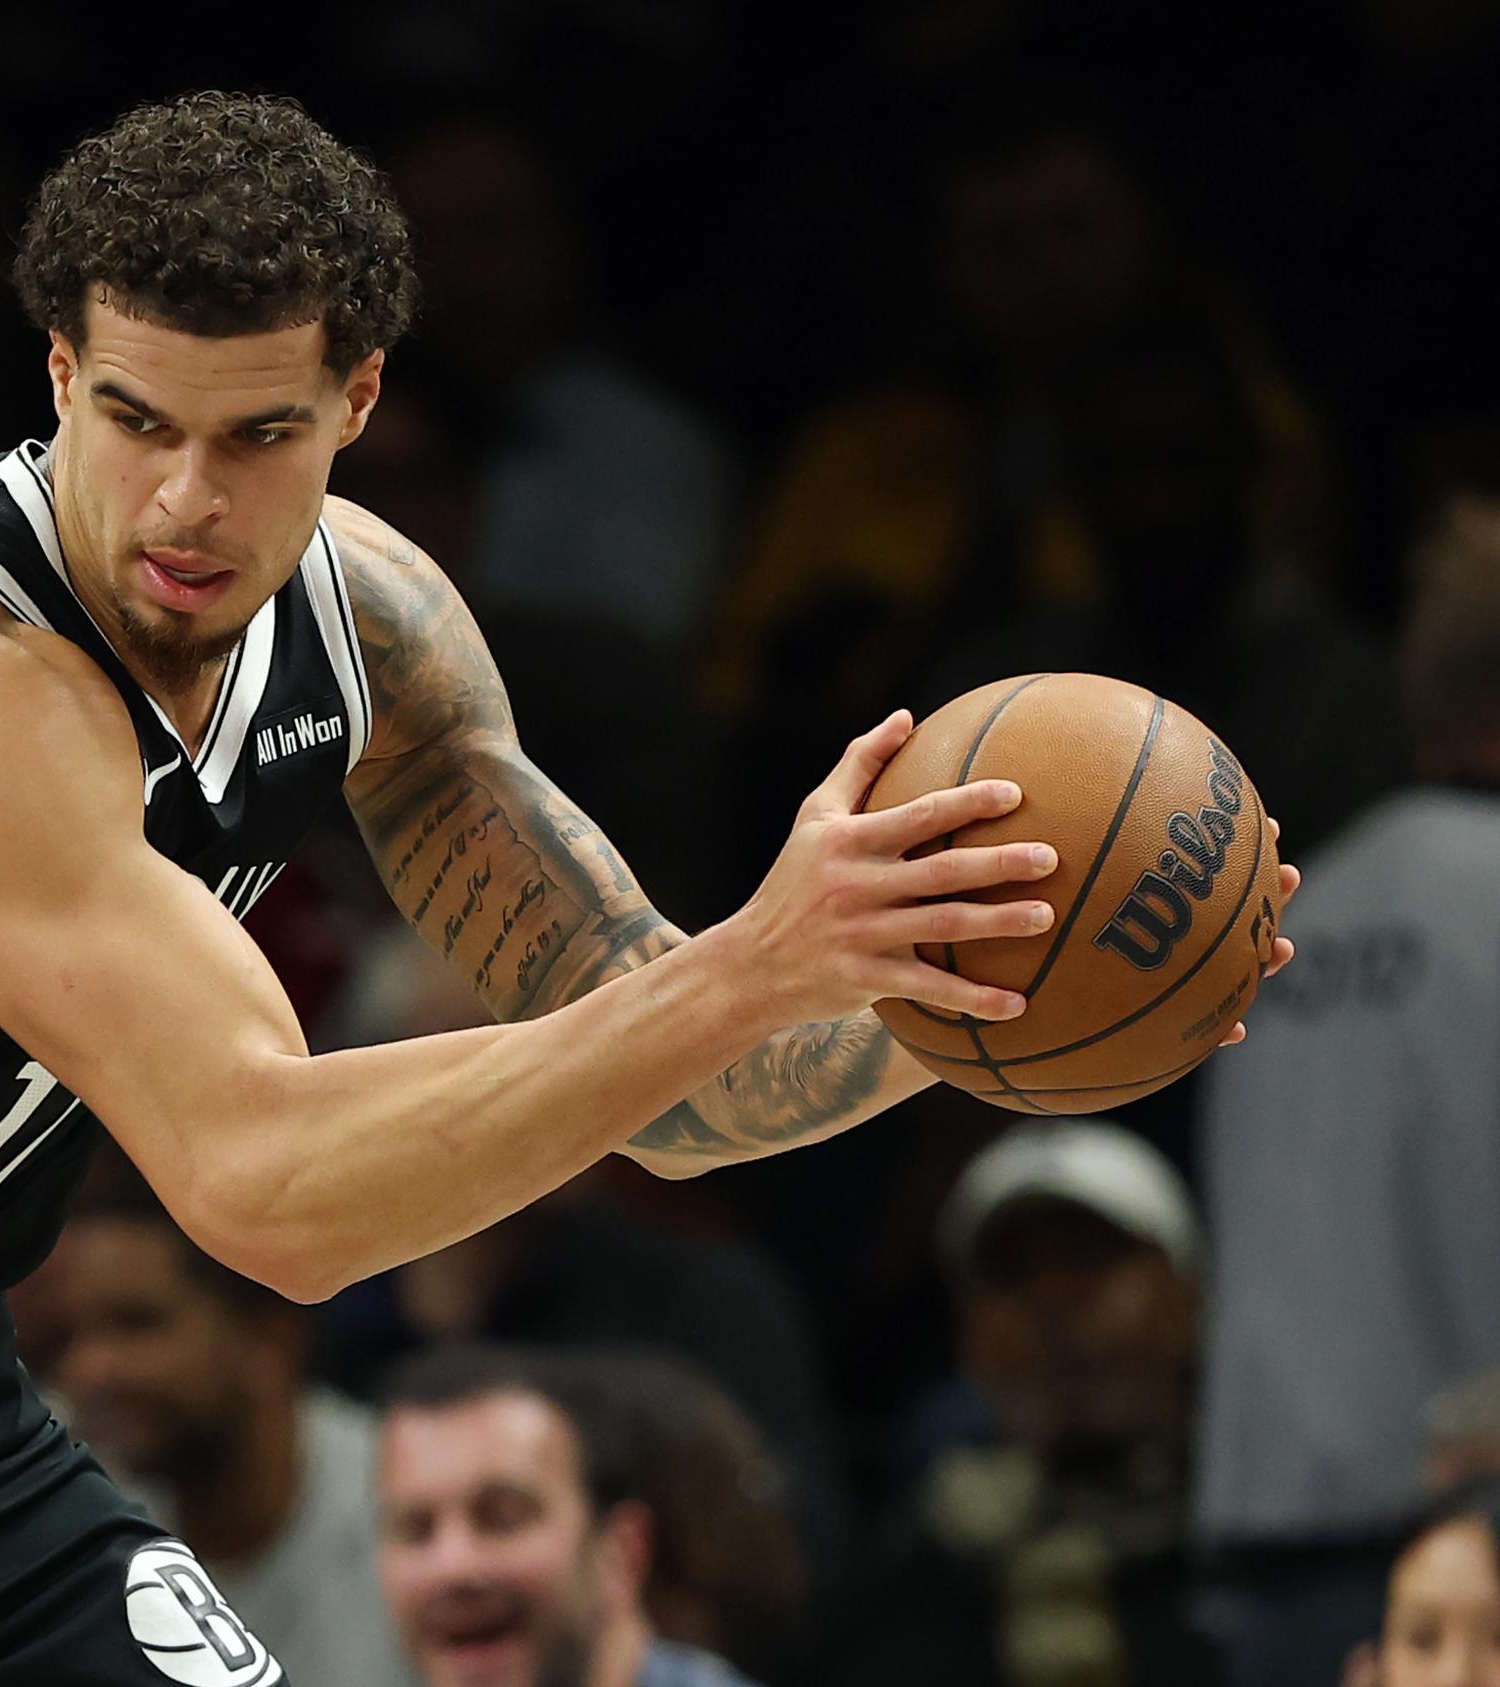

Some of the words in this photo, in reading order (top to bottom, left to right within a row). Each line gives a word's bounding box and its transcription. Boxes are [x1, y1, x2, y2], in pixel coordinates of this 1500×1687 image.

[256, 728, 278, 767] All
[277, 724, 298, 757] In
[294, 713, 343, 749] Won
